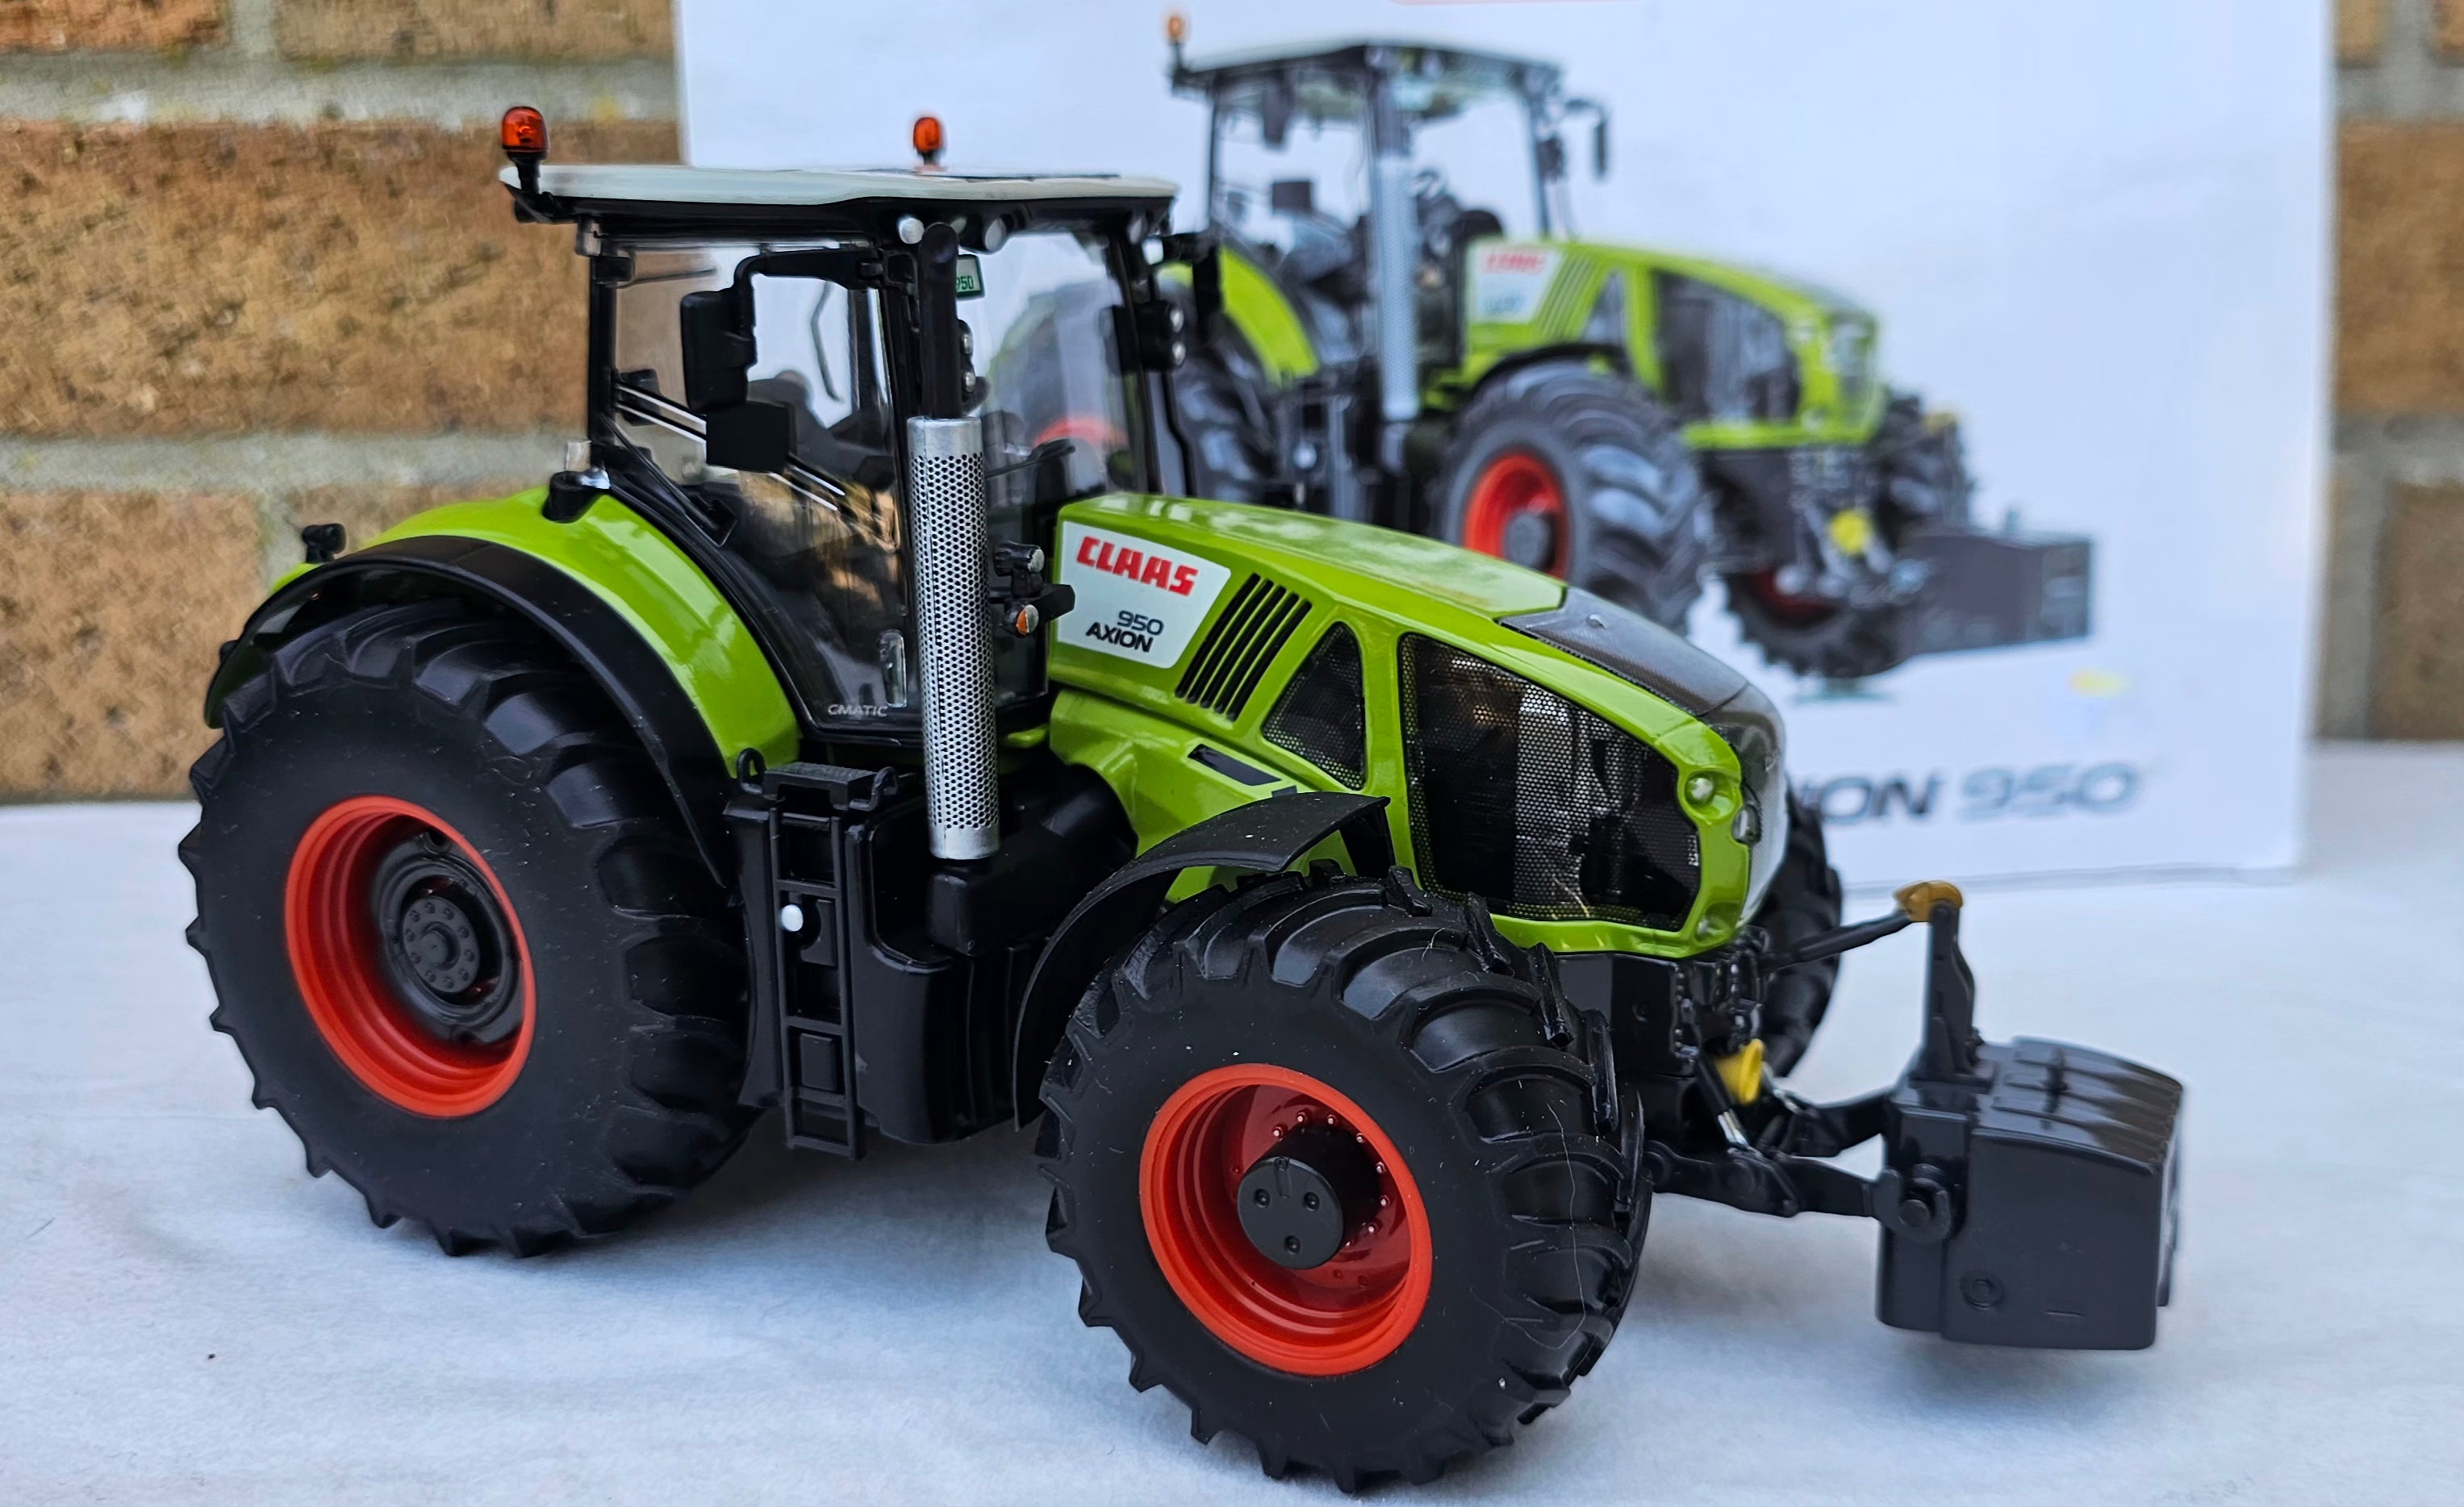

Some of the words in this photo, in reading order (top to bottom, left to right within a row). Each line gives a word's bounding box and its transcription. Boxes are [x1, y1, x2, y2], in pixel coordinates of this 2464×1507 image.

[1076, 536, 1199, 596] CLAAS
[1085, 622, 1154, 653] AXION
[1117, 610, 1164, 636] 950
[828, 704, 888, 717] CMATIC
[1959, 763, 2141, 820] 950
